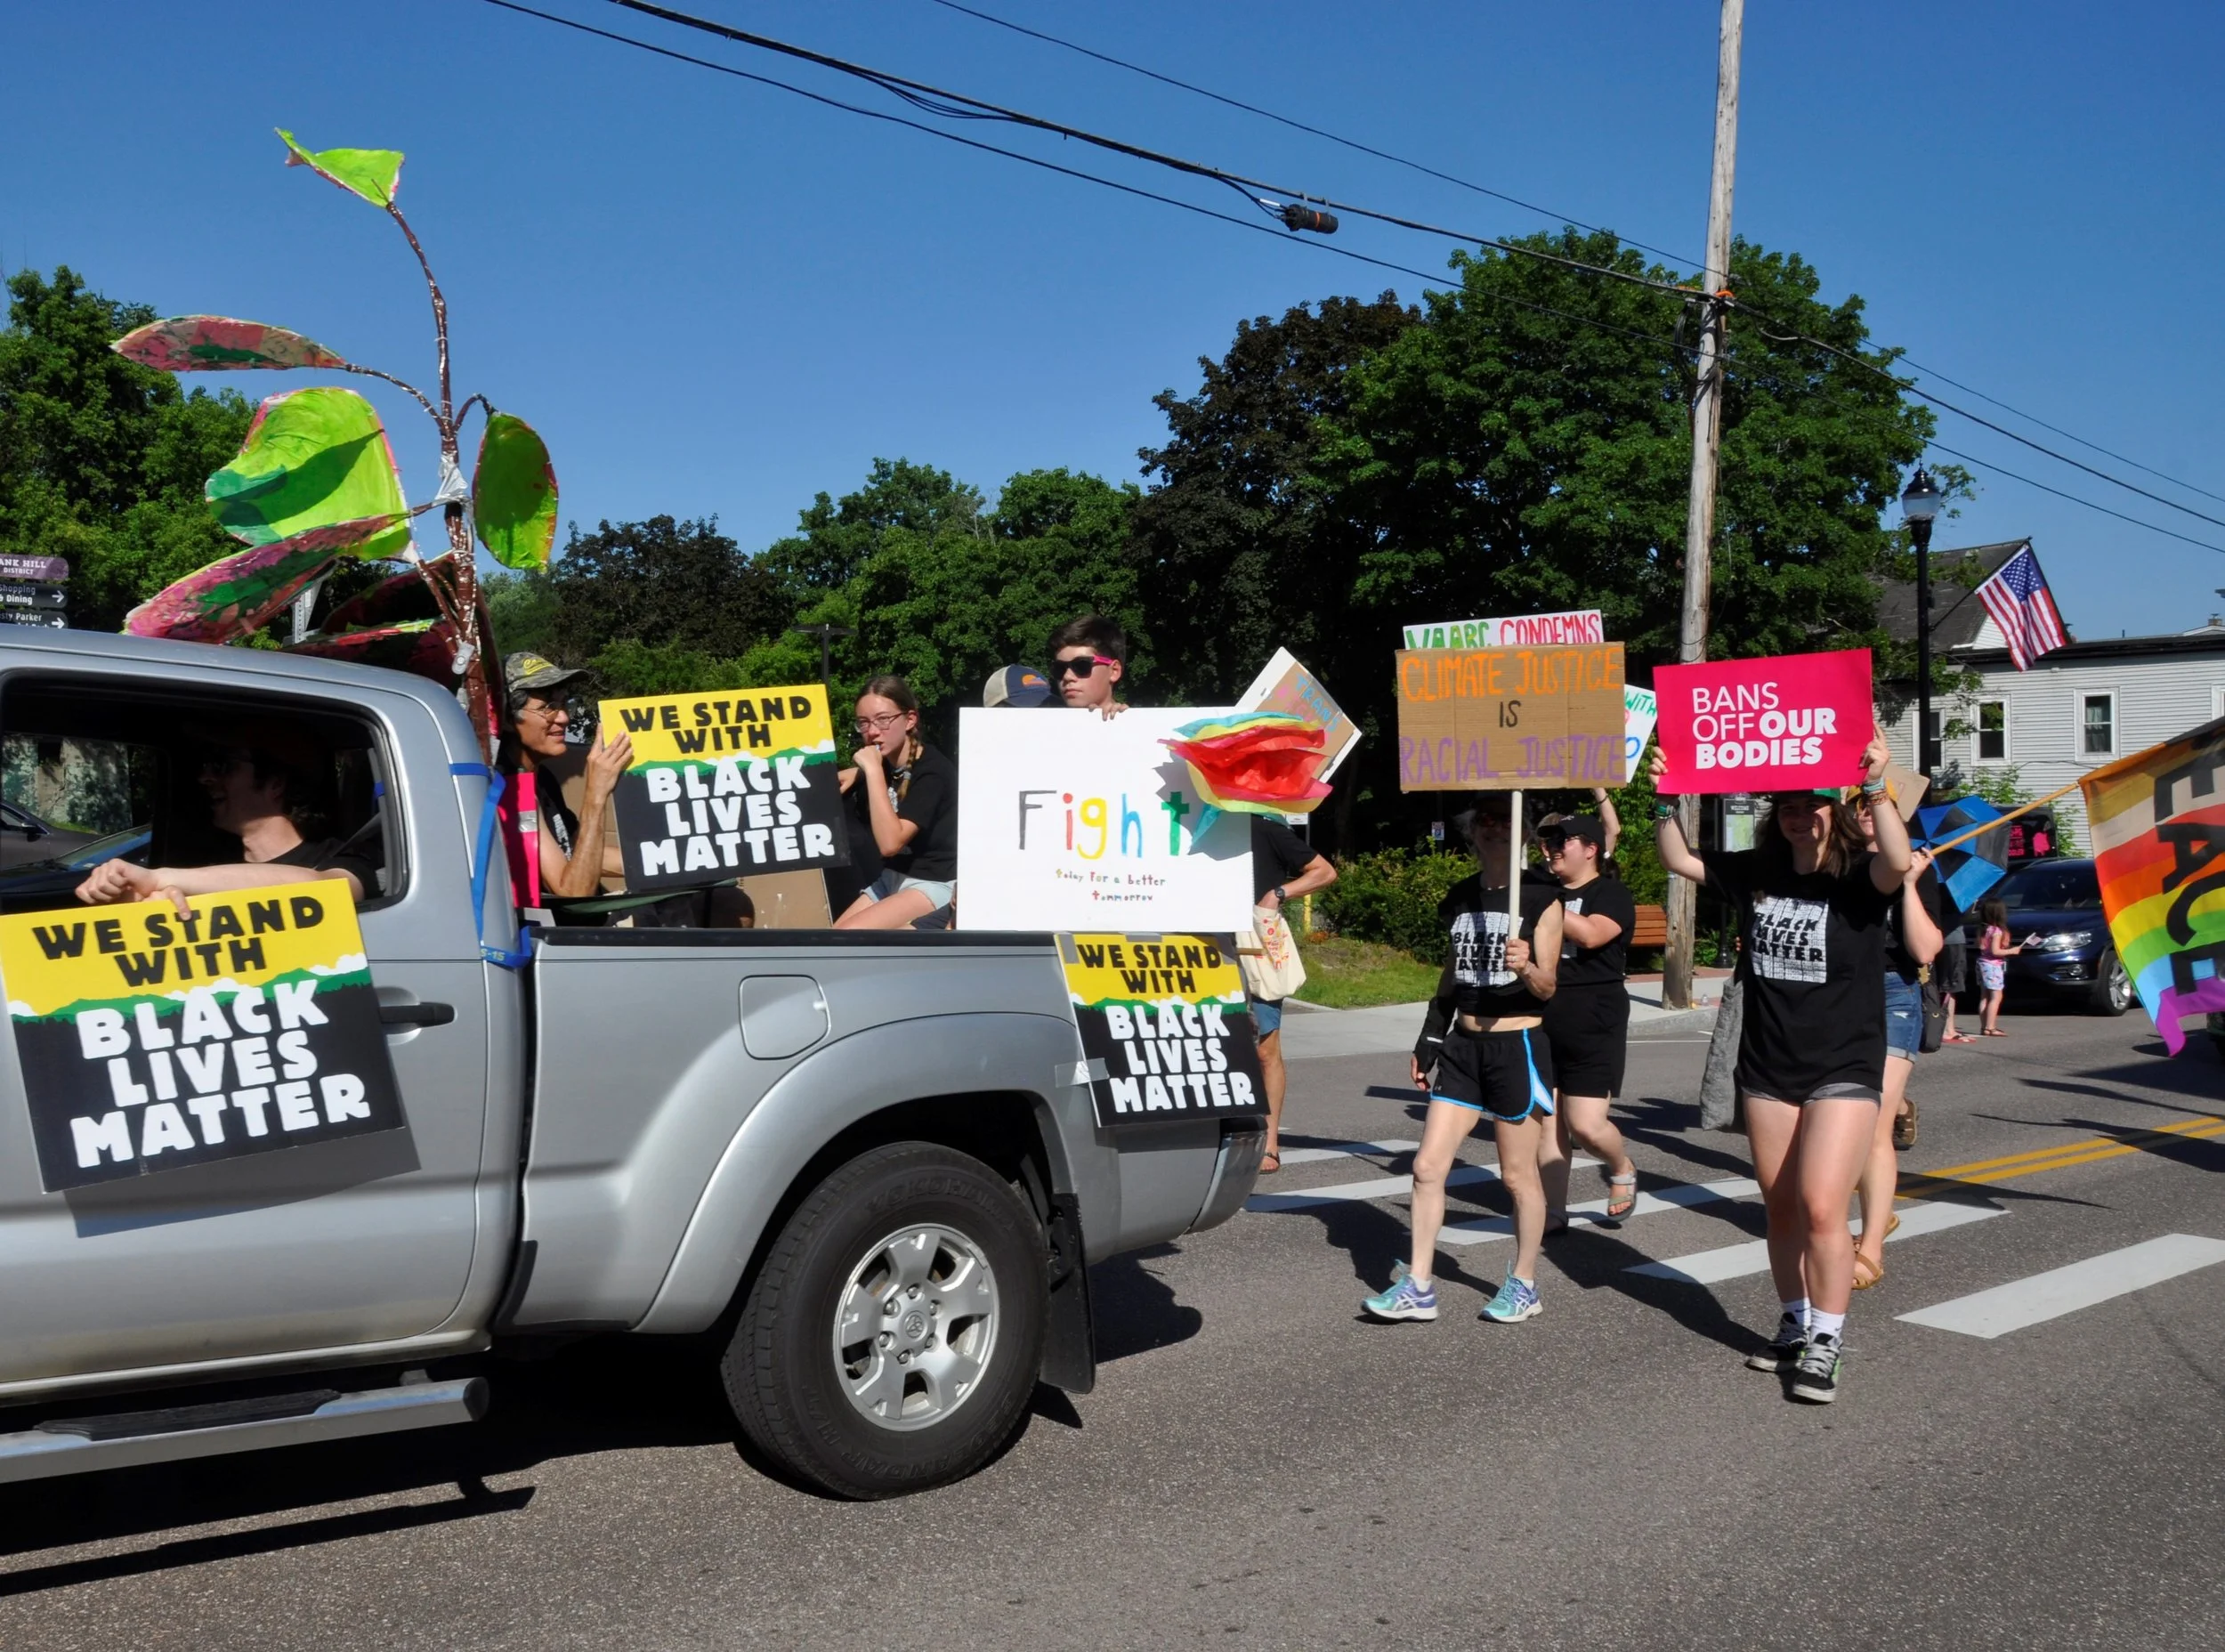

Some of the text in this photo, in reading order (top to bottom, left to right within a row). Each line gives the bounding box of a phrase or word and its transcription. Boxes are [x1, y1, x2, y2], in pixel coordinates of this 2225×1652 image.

[3, 567, 34, 575] DISTRICT
[22, 560, 47, 569] HILL
[6, 595, 33, 605] Dining
[15, 612, 42, 621] Parker
[1500, 613, 1600, 646] CONDEMNS
[1402, 647, 1625, 702] CLIMATE JUSTICE
[619, 696, 812, 733] WE STAND
[1295, 672, 1339, 733] TRANS
[1499, 700, 1521, 728] IS
[1692, 682, 1779, 714] BANS
[673, 724, 772, 754] WITH
[1692, 708, 1838, 742] OFF OUR
[1398, 736, 1500, 784] RACIAL
[1516, 733, 1627, 781] JUSTICE
[1695, 736, 1824, 770] BODIES
[645, 756, 811, 803] BLACK
[665, 791, 801, 837] LIVES
[1018, 790, 1190, 860] Fight
[639, 823, 835, 877] MATTER
[1090, 871, 1109, 882] for
[1113, 876, 1121, 884] a
[1128, 874, 1166, 886] better
[32, 895, 325, 960] WE STAND
[114, 937, 267, 987] WITH
[1076, 944, 1222, 968] WE STAND
[1120, 969, 1196, 993] WITH
[76, 979, 329, 1059] BLACK
[1104, 1001, 1231, 1040] BLACK
[109, 1030, 318, 1107] LIVES
[1124, 1038, 1227, 1075] LIVES
[1109, 1072, 1256, 1113] MATTER
[69, 1073, 371, 1169] MATTER
